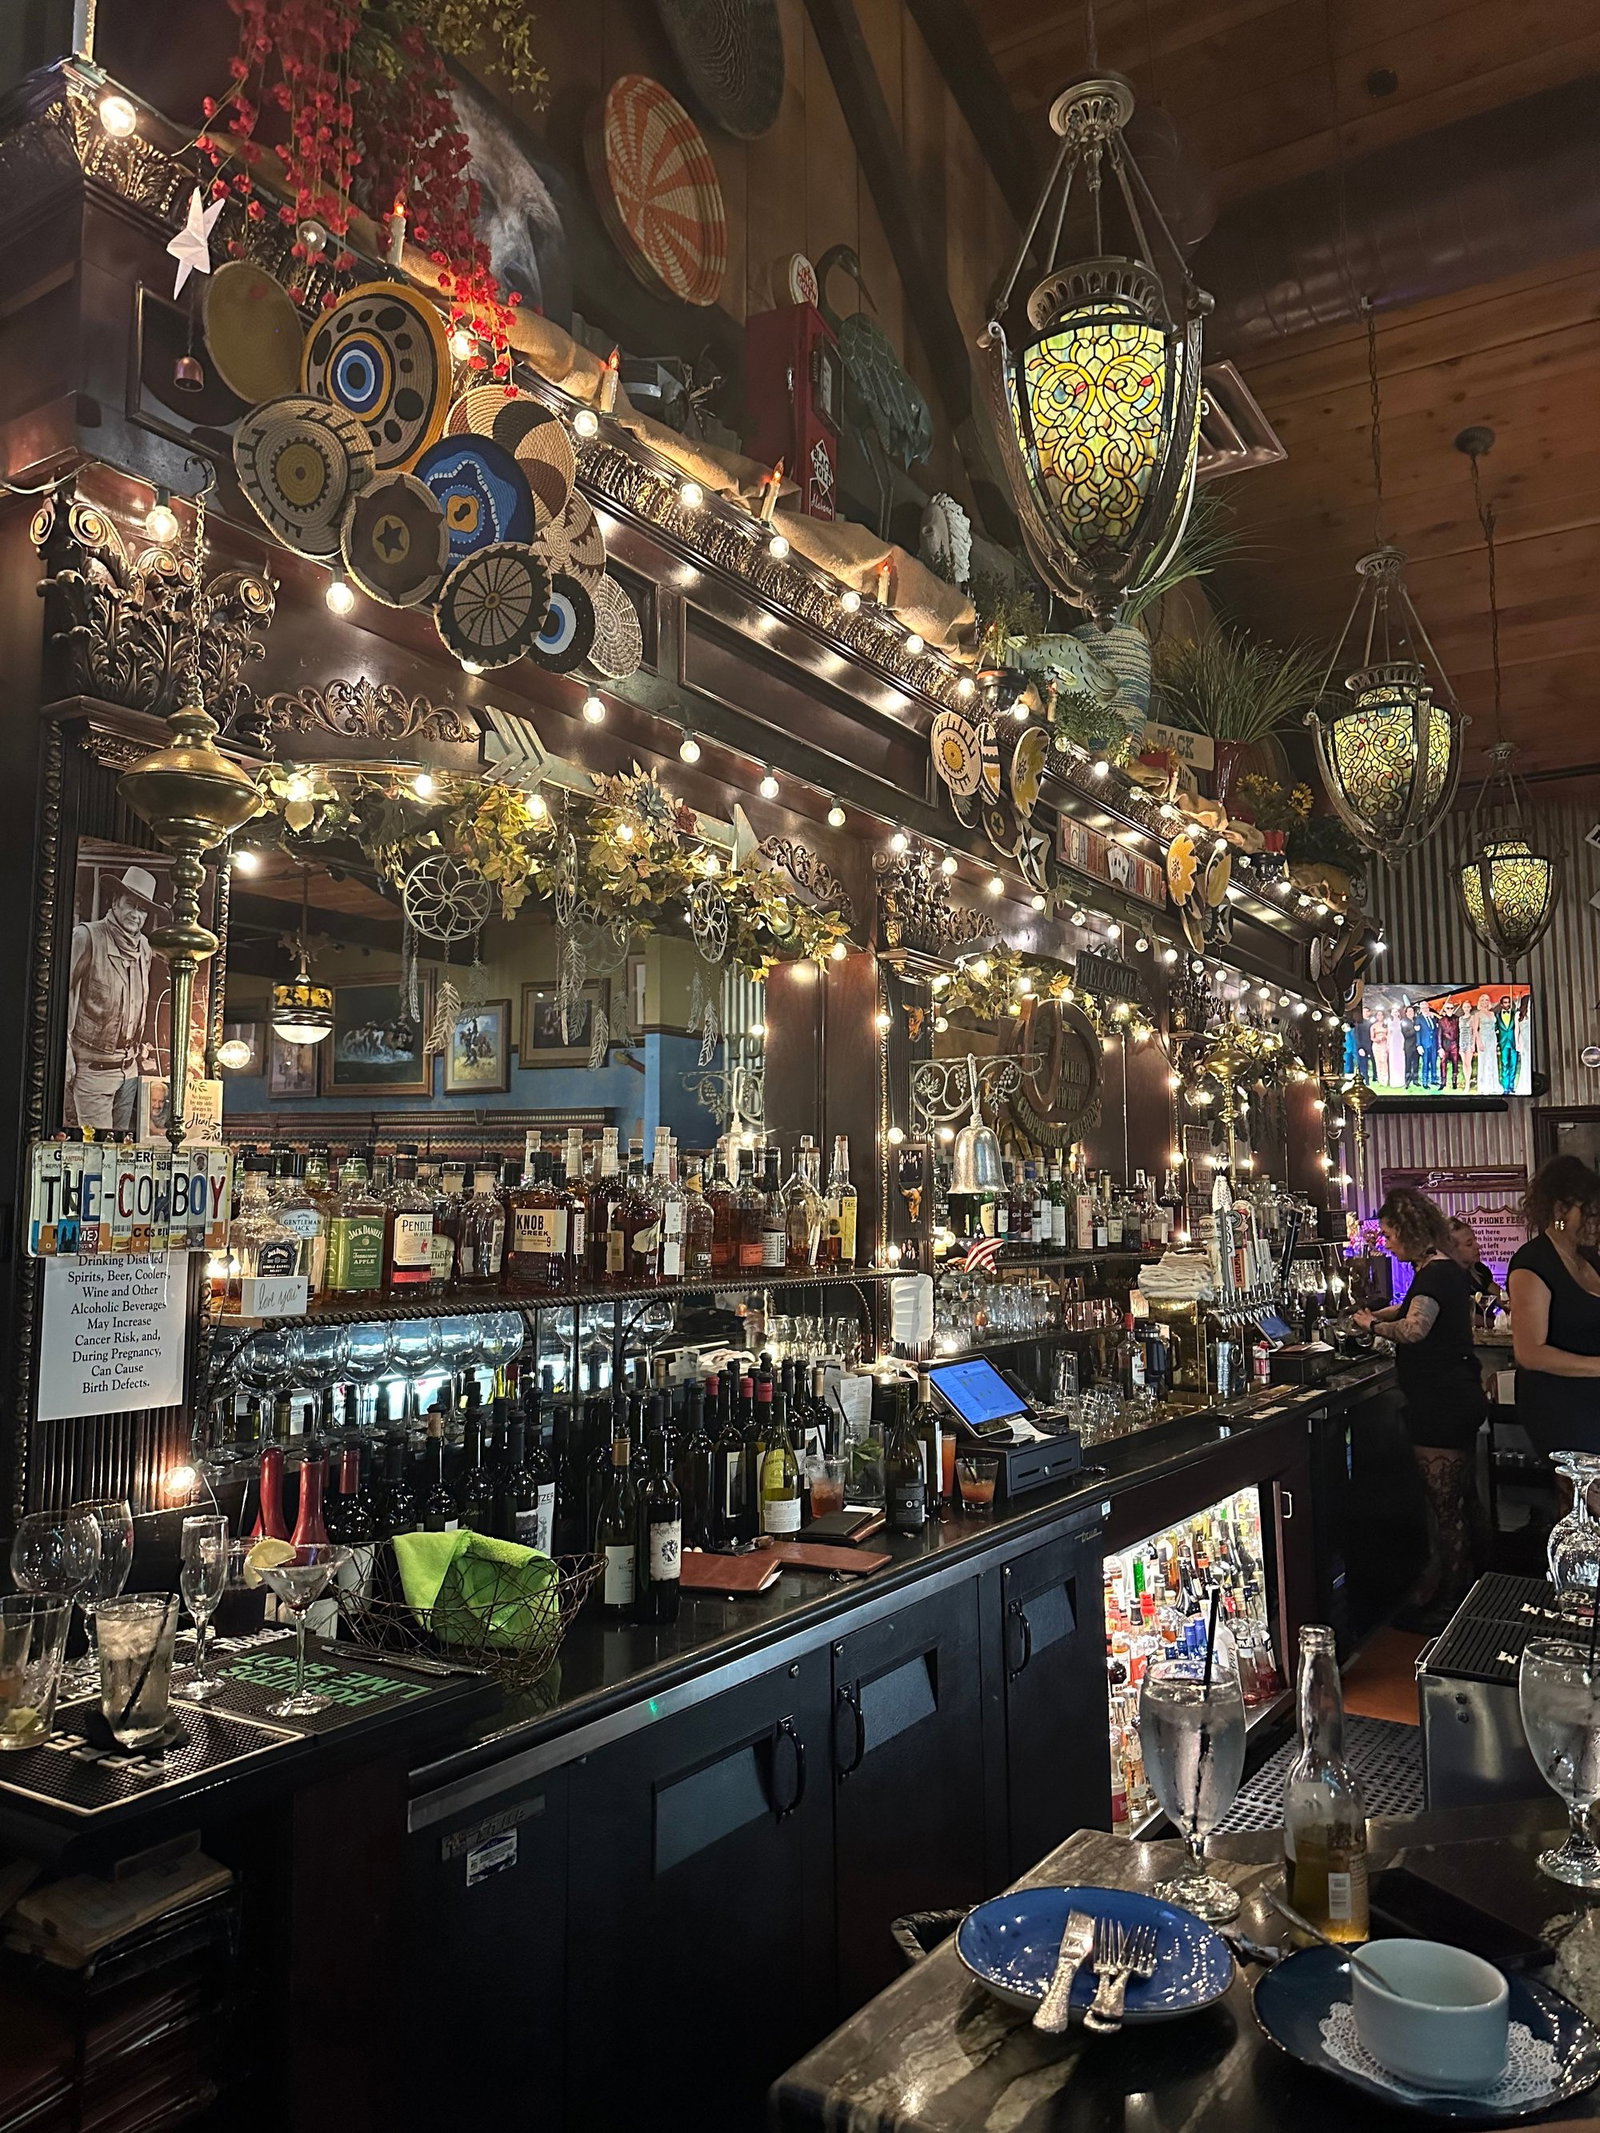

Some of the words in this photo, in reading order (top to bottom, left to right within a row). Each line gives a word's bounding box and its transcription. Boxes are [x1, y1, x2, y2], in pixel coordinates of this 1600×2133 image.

[1157, 729, 1195, 759] TACK
[1080, 958, 1136, 998] WELCOME
[516, 1214, 544, 1231] KNOB
[1480, 1216, 1504, 1225] PHONE
[348, 1226, 362, 1240] JACK
[521, 1229, 549, 1237] CREEK
[546, 1237, 552, 1248] 9
[78, 1254, 124, 1267] Drinking
[68, 1271, 105, 1283] Spirits,
[107, 1270, 132, 1282] Beer,
[134, 1269, 171, 1280] Coolers,
[82, 1287, 109, 1298] Wine
[111, 1286, 129, 1297] and
[132, 1285, 158, 1296] Other
[278, 1288, 298, 1312] you
[71, 1302, 119, 1315] Alcoholic
[122, 1301, 167, 1314] Beverages
[87, 1318, 110, 1331] May
[112, 1317, 152, 1328] Increase
[75, 1335, 111, 1347] Cancer
[114, 1332, 139, 1344] Risk,
[141, 1330, 161, 1342] and,
[72, 1351, 108, 1364] During
[111, 1347, 162, 1361] Pregnancy,
[91, 1366, 111, 1377] Can
[114, 1364, 144, 1375] Cause
[82, 1382, 109, 1394] Birth
[112, 1379, 150, 1392] Defects.
[234, 1652, 339, 1678] SHOT
[331, 1671, 433, 1699] LIME
